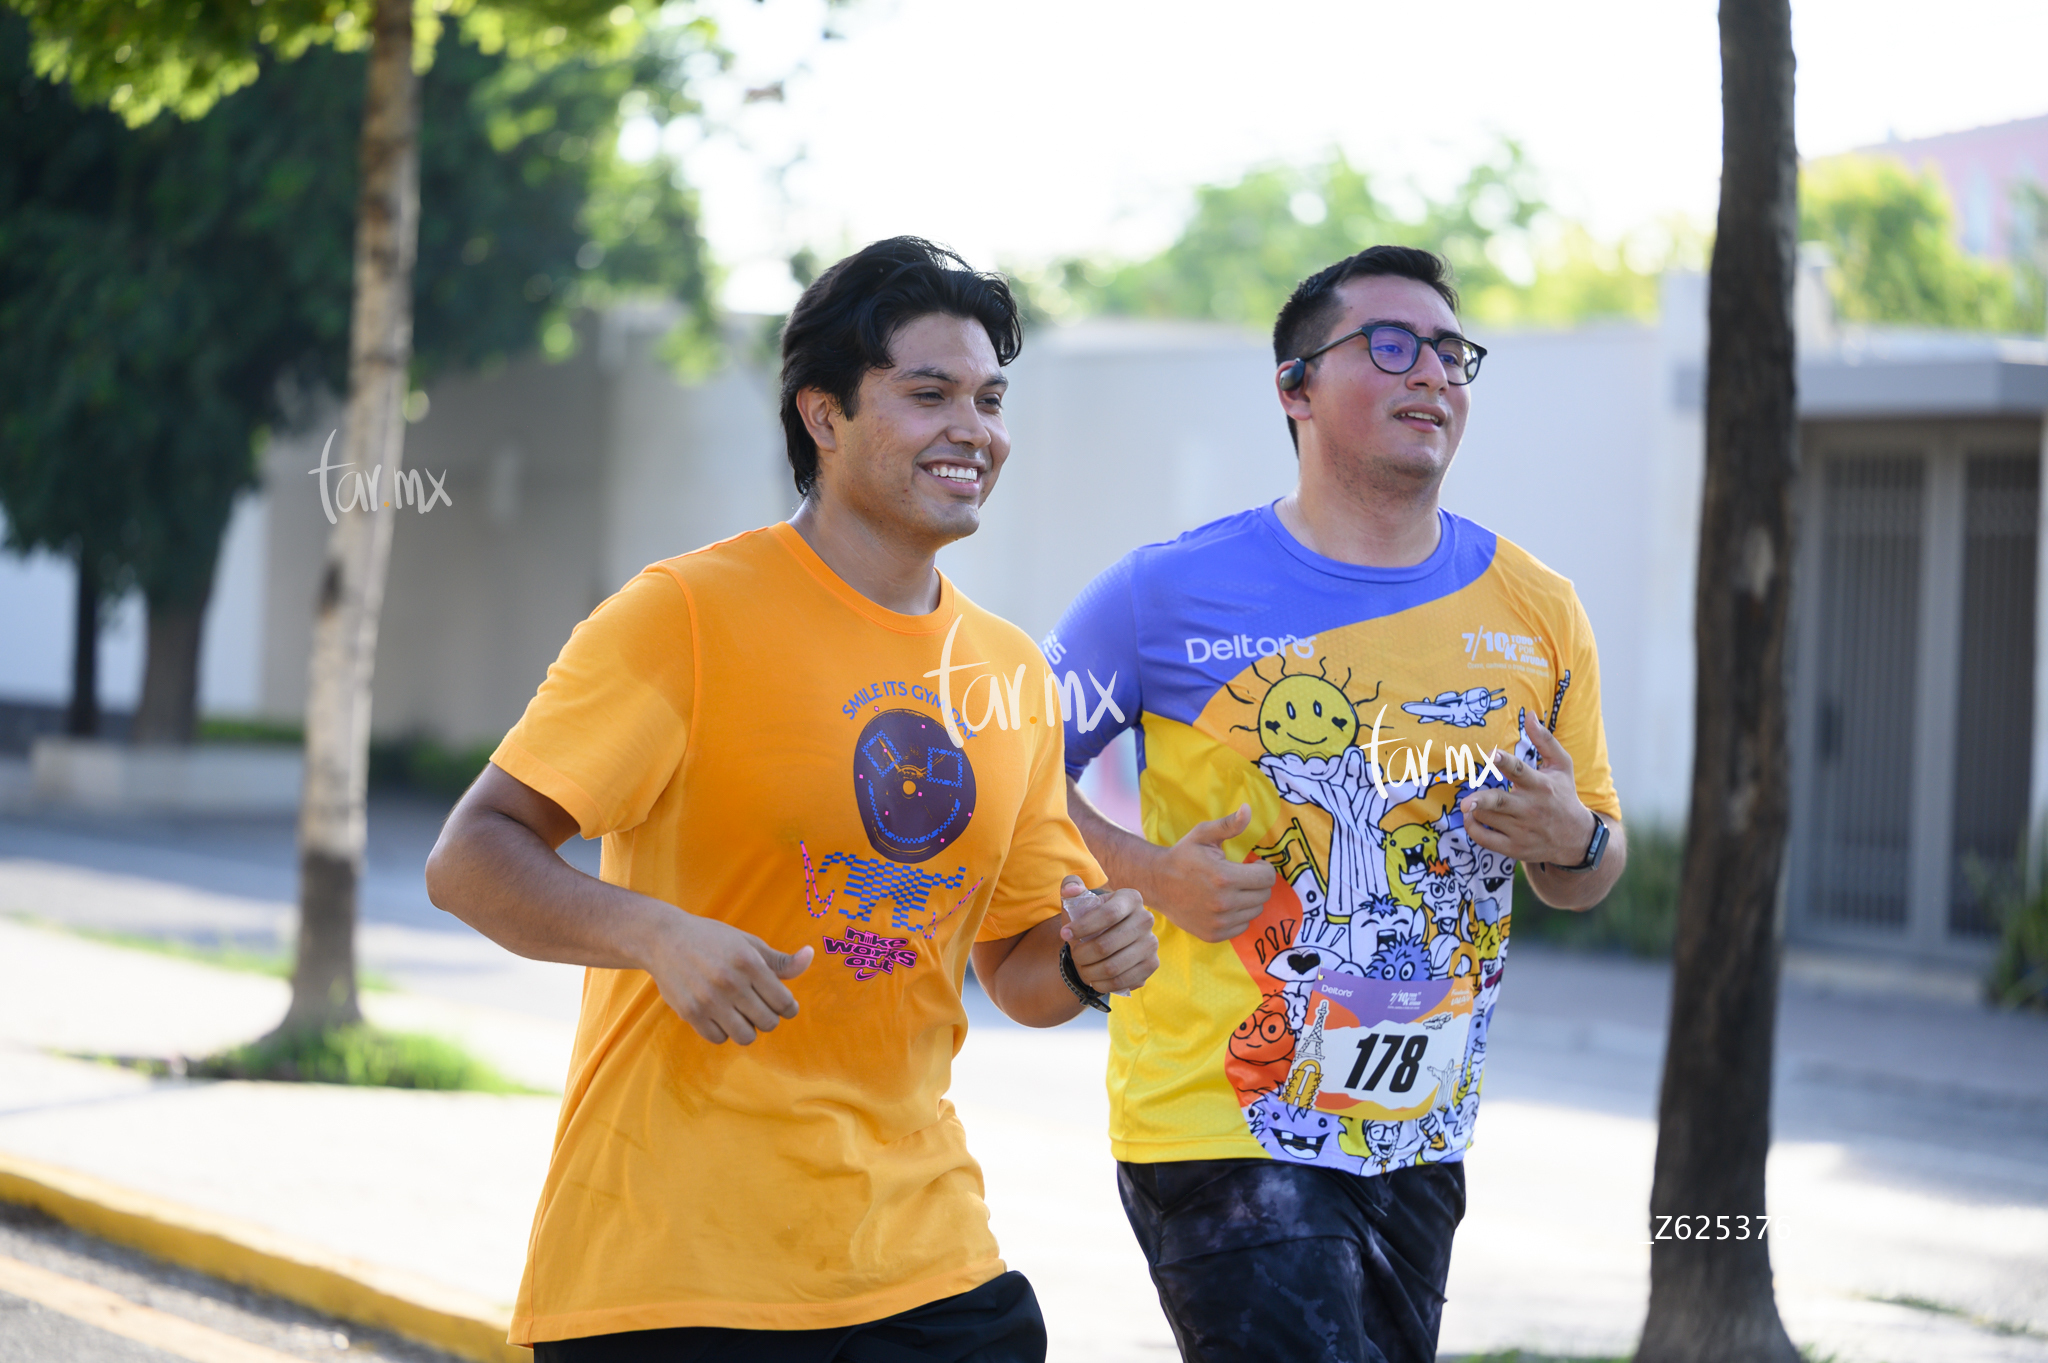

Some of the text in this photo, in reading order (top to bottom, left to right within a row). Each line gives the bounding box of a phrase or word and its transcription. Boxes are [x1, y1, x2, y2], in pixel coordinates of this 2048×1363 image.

[1185, 634, 1317, 664] Deltoro
[842, 681, 977, 740] SMILE ITS GYM DAY
[1344, 1033, 1429, 1093] 178
